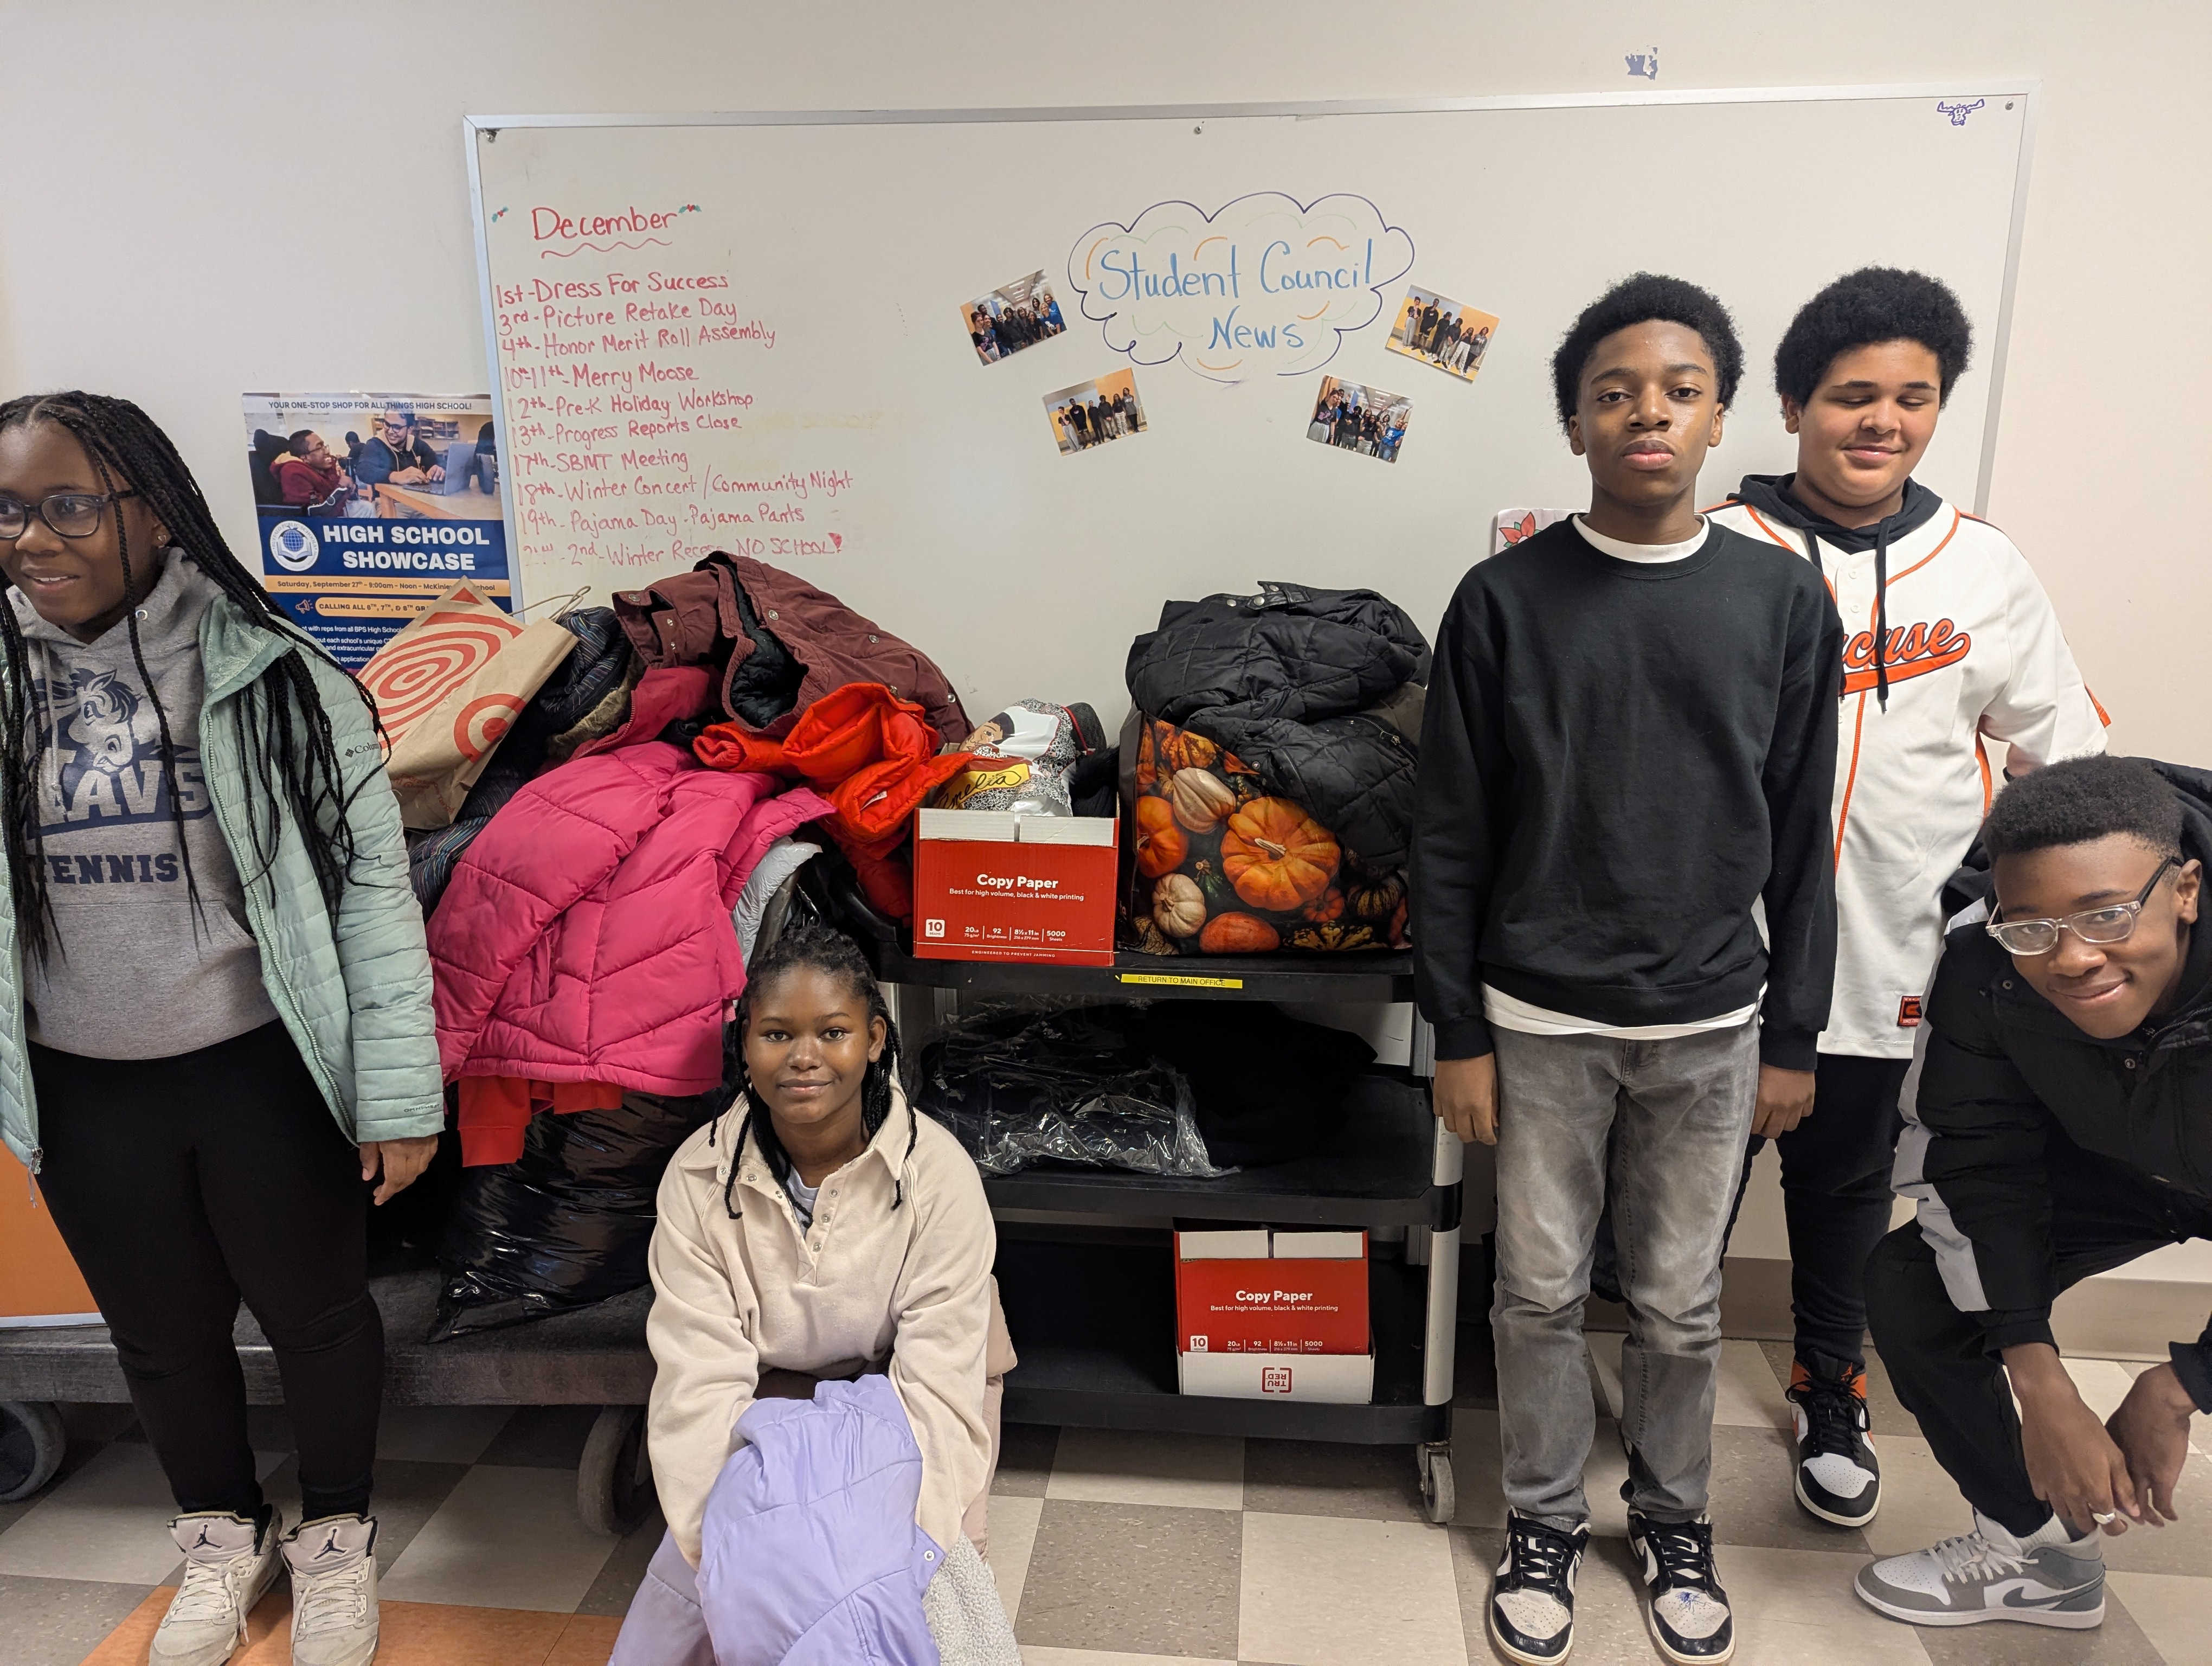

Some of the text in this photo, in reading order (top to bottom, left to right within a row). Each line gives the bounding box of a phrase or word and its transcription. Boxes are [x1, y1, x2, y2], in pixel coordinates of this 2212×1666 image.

[532, 207, 677, 240] December
[1099, 238, 1373, 300] Student Council
[607, 273, 640, 296] For
[648, 272, 729, 292] Success
[626, 299, 692, 322] Retake
[699, 298, 737, 324] Day
[602, 328, 649, 353] Merit
[658, 326, 690, 347] Roll
[698, 321, 776, 349] Assembly
[1208, 305, 1304, 349] News
[639, 360, 700, 381] Moose
[385, 402, 414, 410] THINGS
[437, 402, 472, 411] SCHOOL!
[611, 395, 672, 419] Holiday
[679, 388, 754, 411] Workshop
[628, 418, 690, 443] Reports
[697, 415, 743, 430] Close
[621, 450, 689, 472] Meeting
[810, 470, 854, 498] Night
[758, 502, 806, 522] Pants
[323, 525, 490, 546] HIGH SCHOOL
[736, 537, 765, 558] NO
[343, 552, 476, 571] SHOWCASE
[38, 747, 210, 827] AVS
[44, 853, 178, 884] ENNIS
[977, 874, 1059, 890] Copy Paper
[975, 889, 989, 898] high
[928, 922, 943, 932] 10
[1236, 1290, 1313, 1304] Copy Paper
[1192, 1337, 1206, 1347] 10
